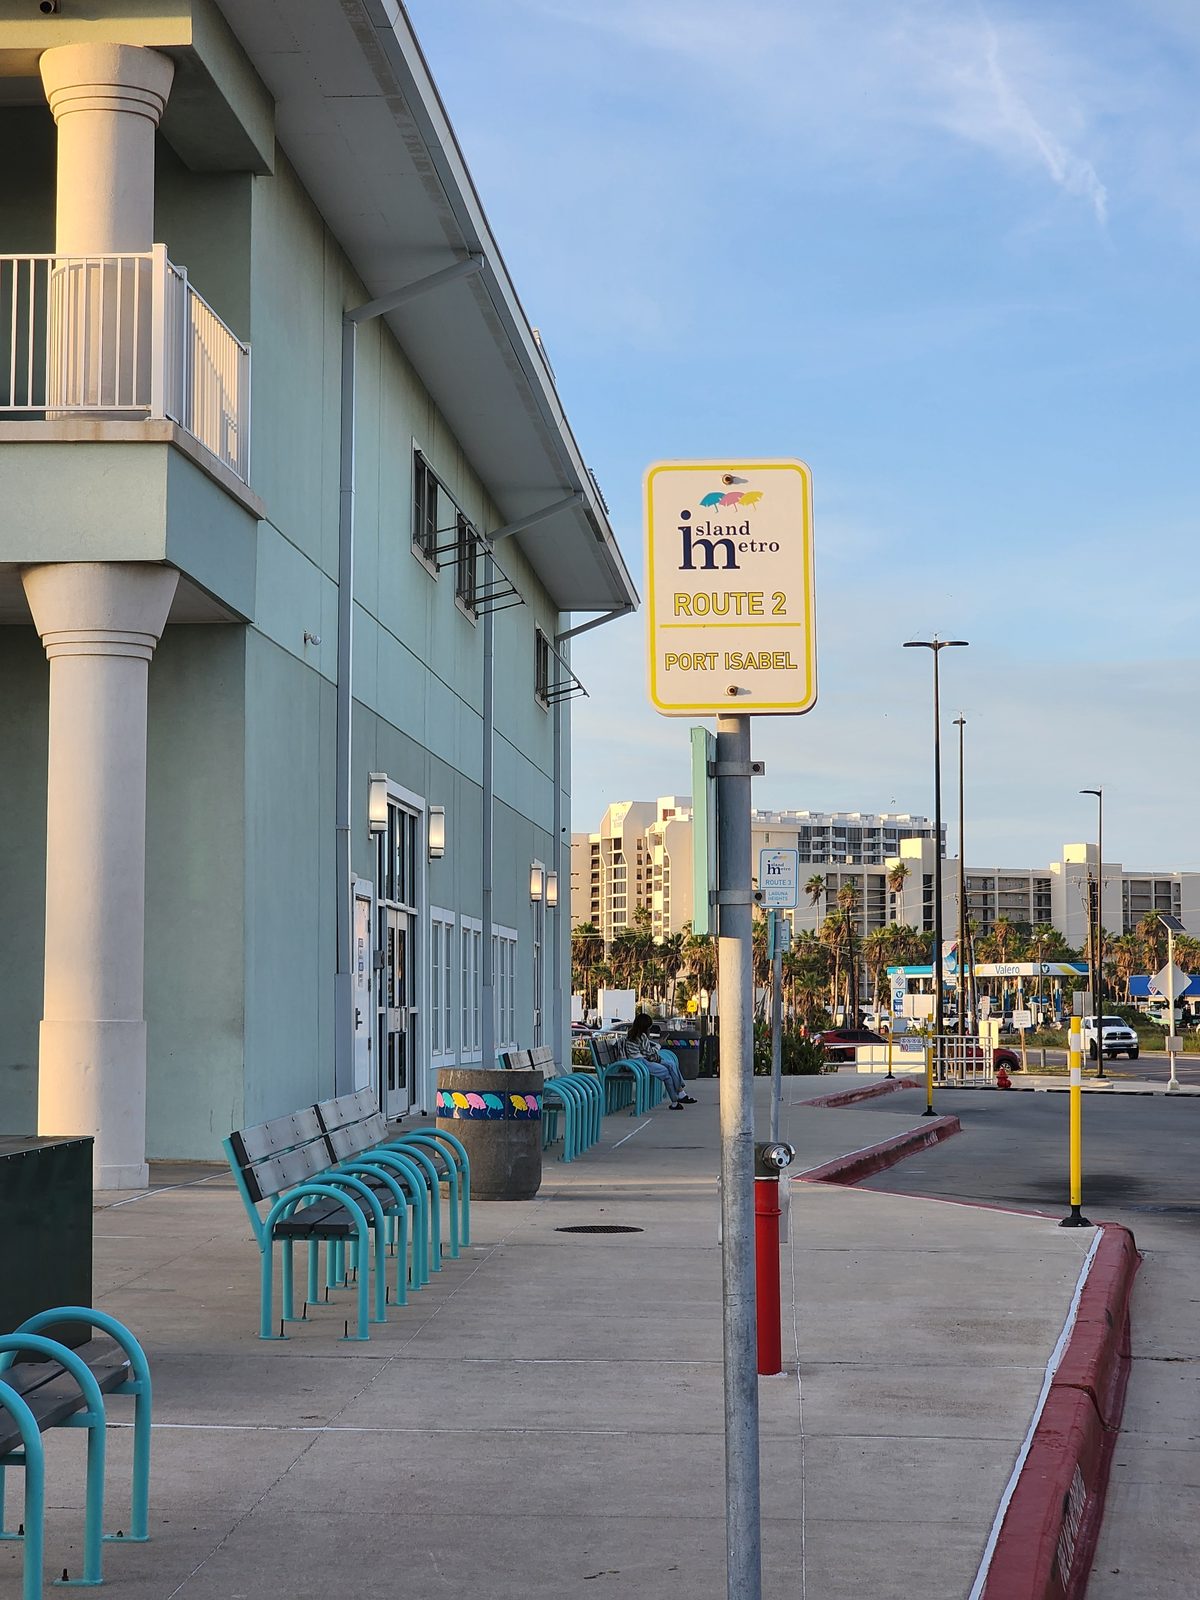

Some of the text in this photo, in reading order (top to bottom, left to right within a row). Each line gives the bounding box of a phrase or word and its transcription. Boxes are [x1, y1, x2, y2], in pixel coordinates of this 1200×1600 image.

[678, 536, 780, 570] metro
[673, 591, 787, 617] ROUTE 2
[665, 651, 798, 672] PORT ISABEL
[995, 965, 1020, 974] Valero
